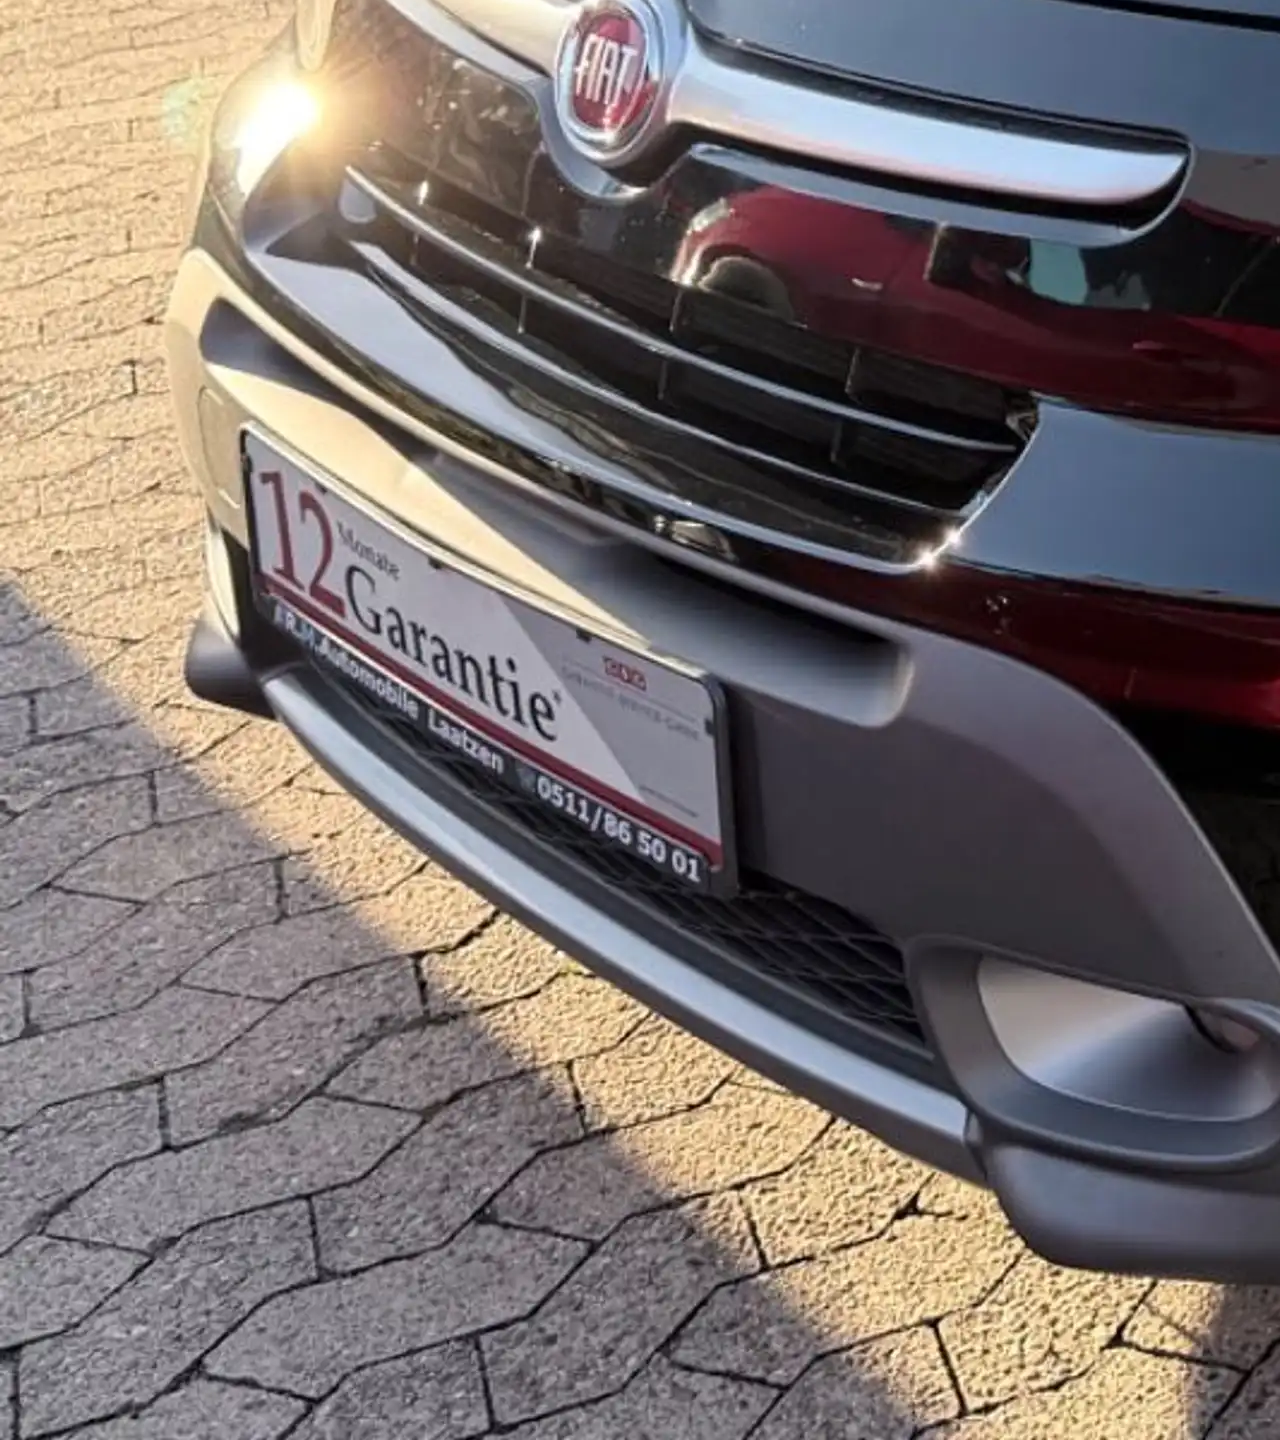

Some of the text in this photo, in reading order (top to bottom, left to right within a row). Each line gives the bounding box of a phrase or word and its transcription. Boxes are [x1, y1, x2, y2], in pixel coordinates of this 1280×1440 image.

[575, 33, 638, 105] FIAT
[260, 470, 346, 618] 12
[428, 708, 503, 774] Laatzen
[536, 774, 633, 846] 0511/86
[636, 820, 667, 863] 50
[671, 848, 701, 883] 01
